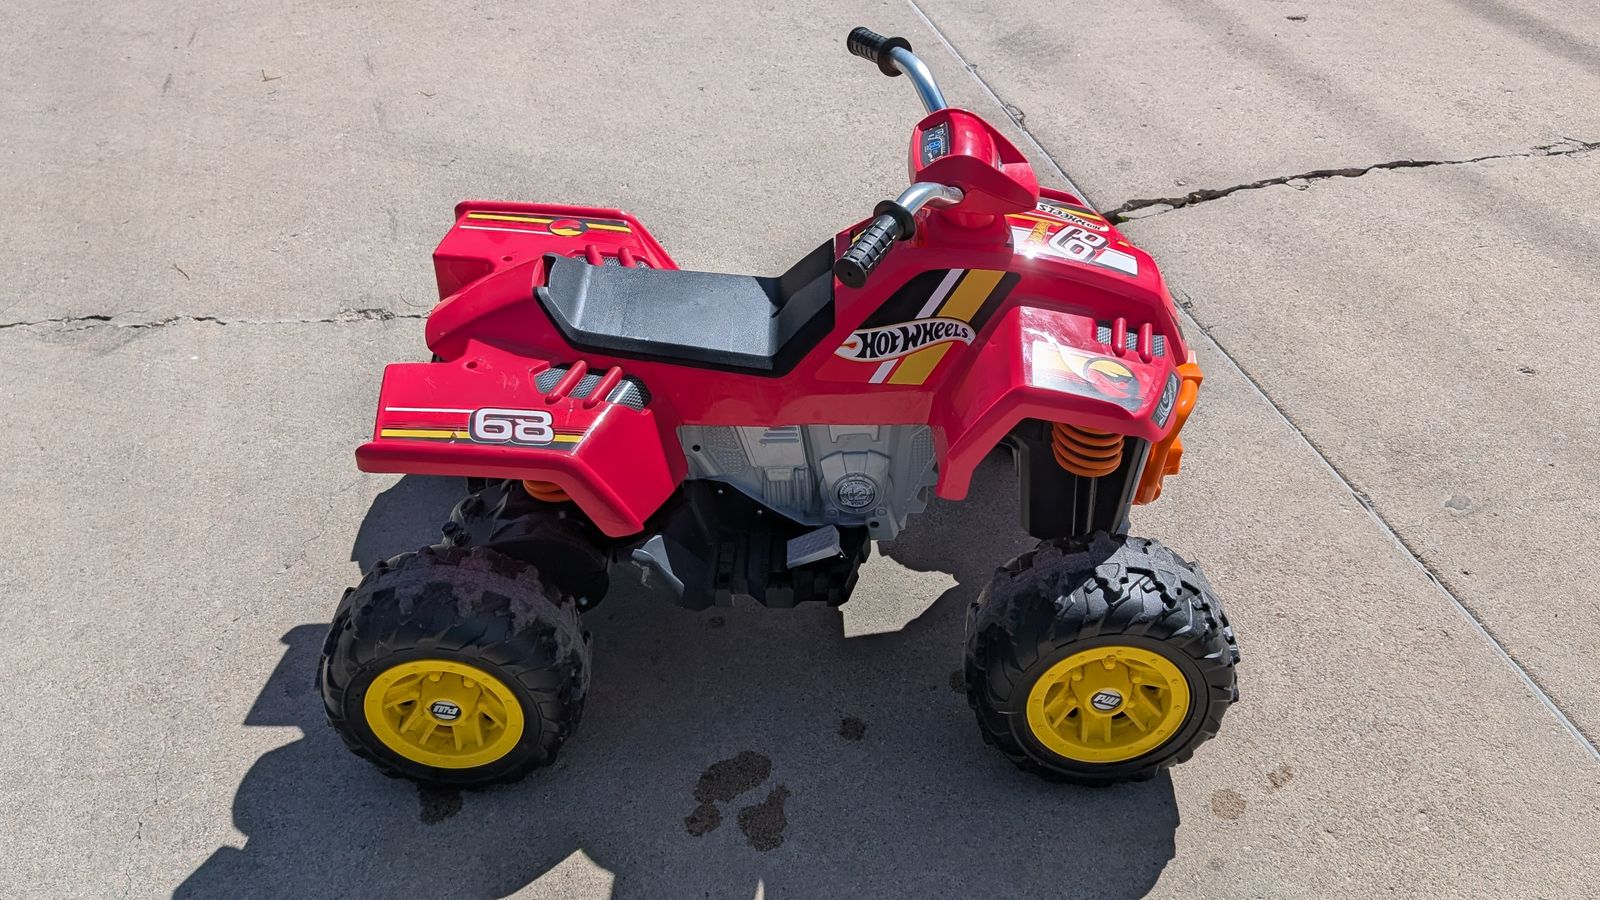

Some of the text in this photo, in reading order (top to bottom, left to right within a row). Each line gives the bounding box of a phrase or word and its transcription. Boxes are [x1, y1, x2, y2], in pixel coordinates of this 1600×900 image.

[1049, 225, 1108, 261] 68
[854, 331, 900, 358] HOT
[470, 407, 554, 444] 68
